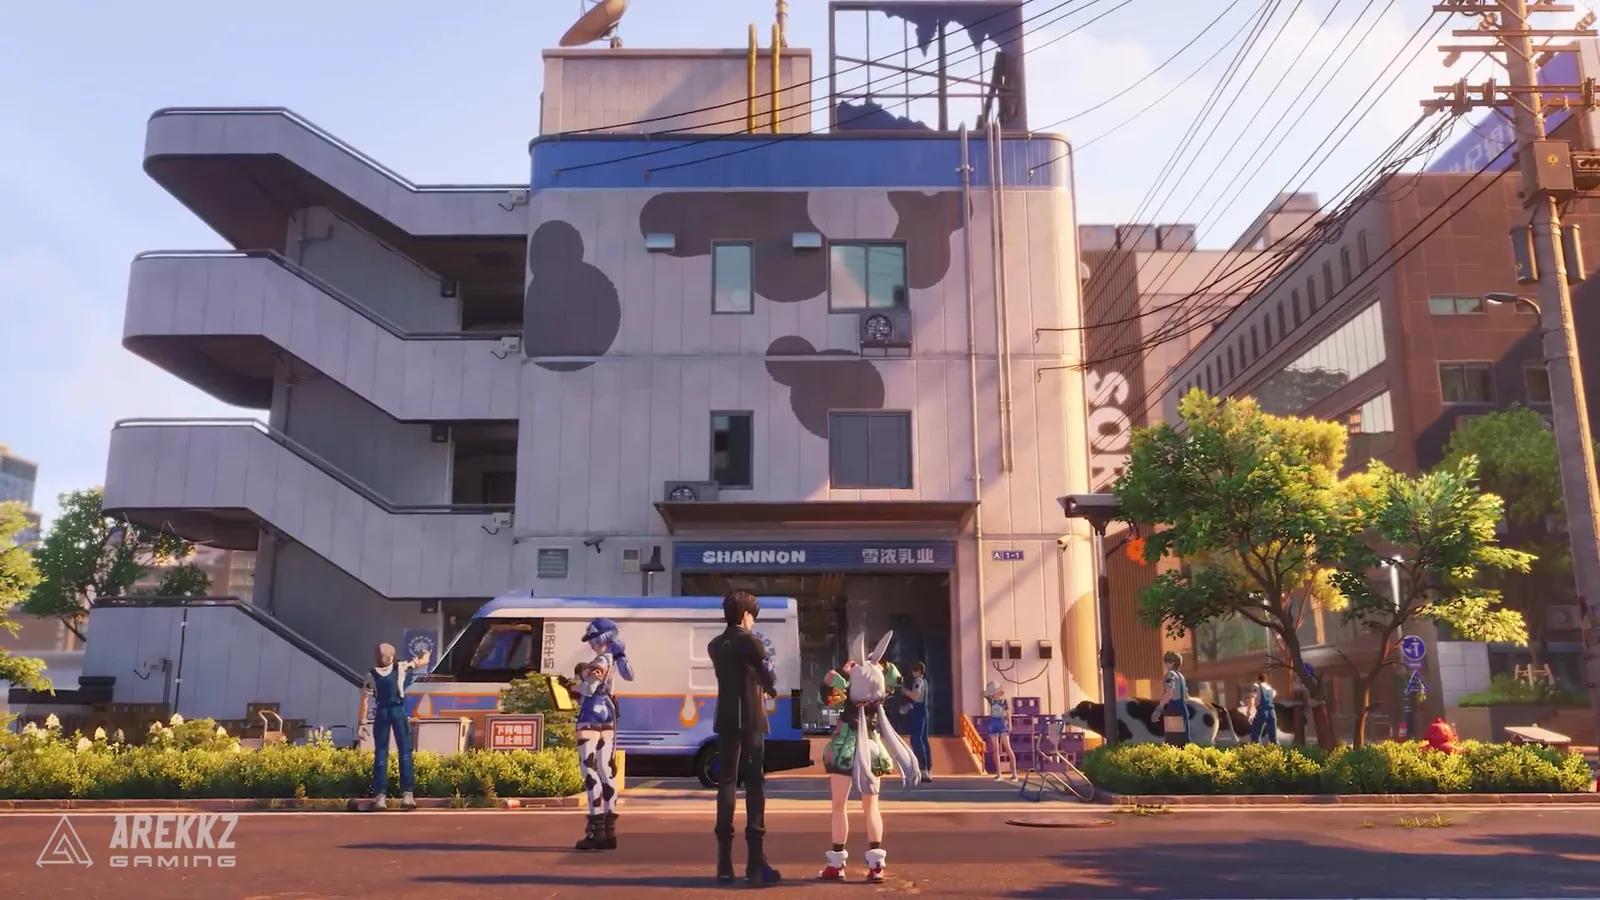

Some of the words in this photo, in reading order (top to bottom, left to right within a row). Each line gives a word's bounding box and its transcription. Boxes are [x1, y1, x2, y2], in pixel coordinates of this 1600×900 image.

[702, 550, 806, 564] SHANNON
[862, 548, 934, 564] 雪浓乳业
[543, 622, 556, 669] 雪浓牛奶
